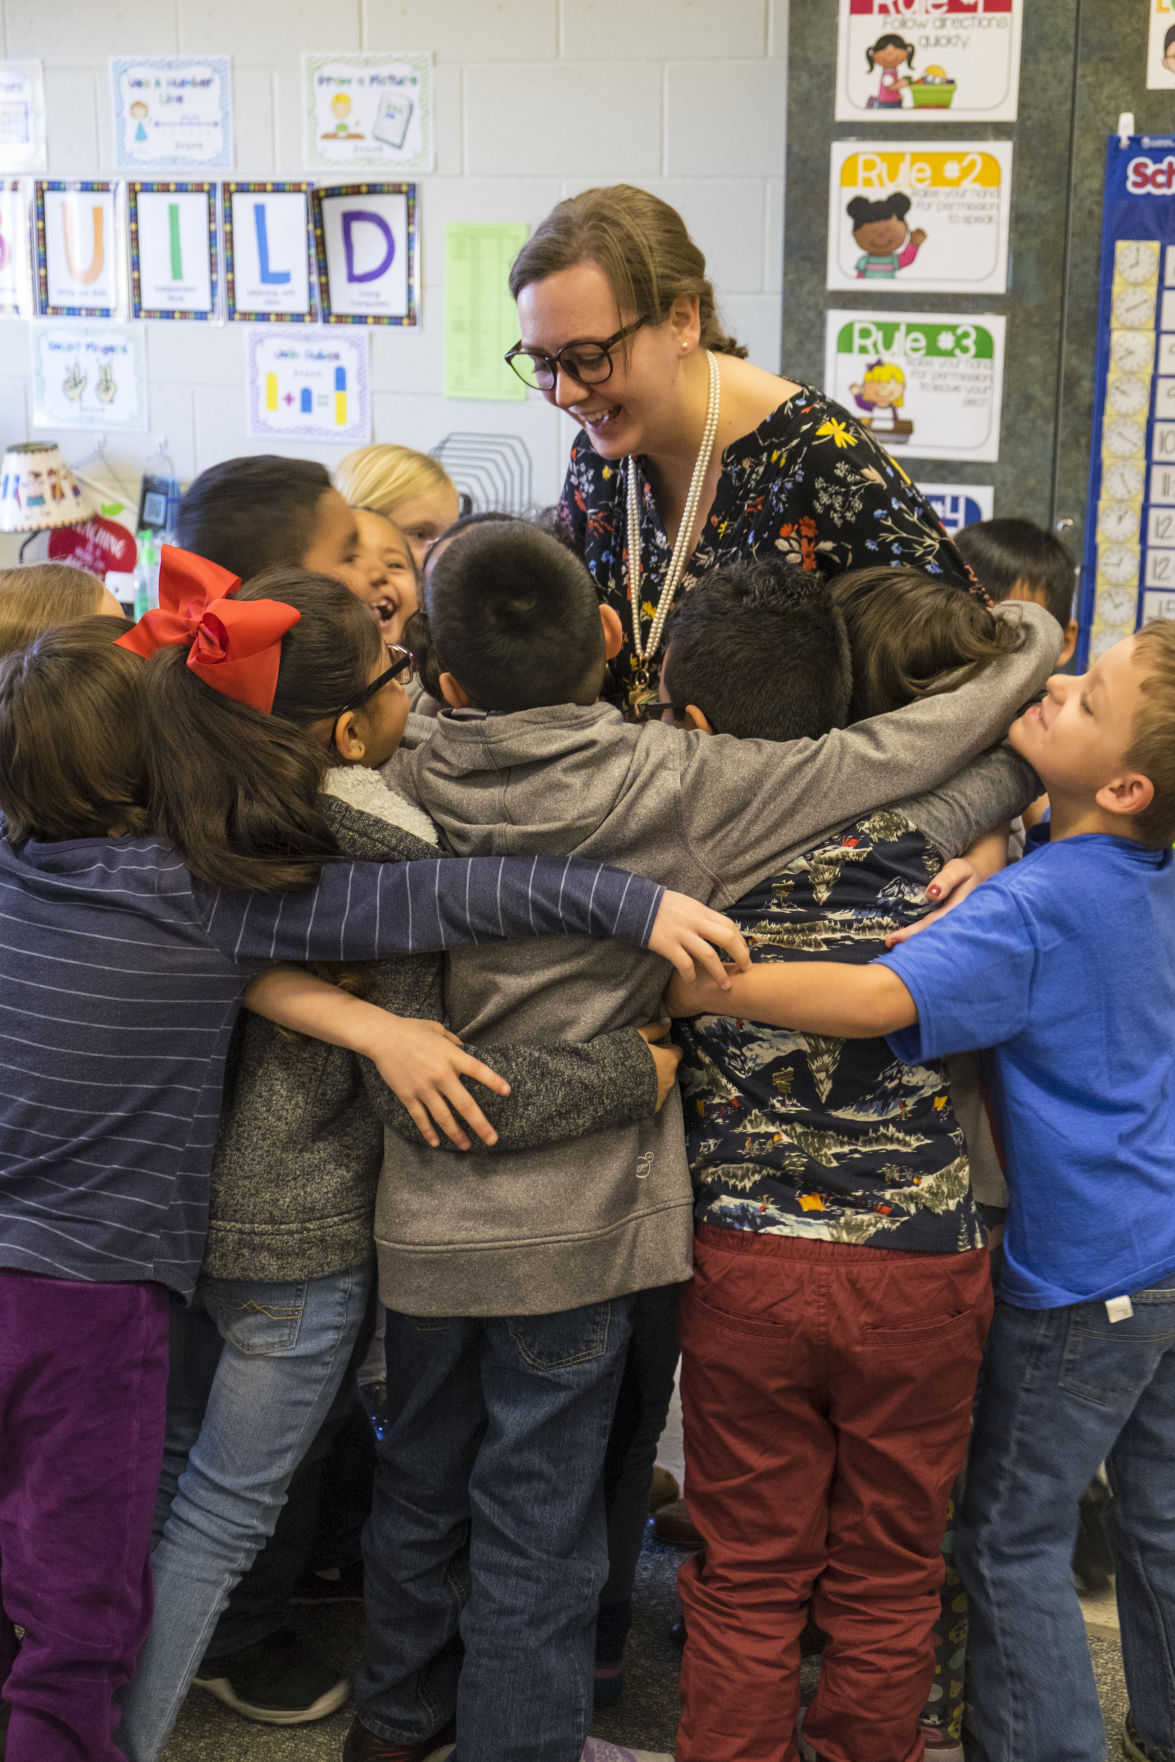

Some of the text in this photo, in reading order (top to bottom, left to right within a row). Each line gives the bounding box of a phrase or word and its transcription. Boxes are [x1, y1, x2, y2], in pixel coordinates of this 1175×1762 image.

[882, 14, 1008, 31] Follow directions
[918, 34, 970, 51] quickly
[858, 153, 983, 188] Rule #2
[61, 201, 105, 286] U
[168, 203, 184, 280] I
[253, 203, 291, 284] L
[341, 210, 395, 284] D
[852, 321, 977, 359] Rule #3
